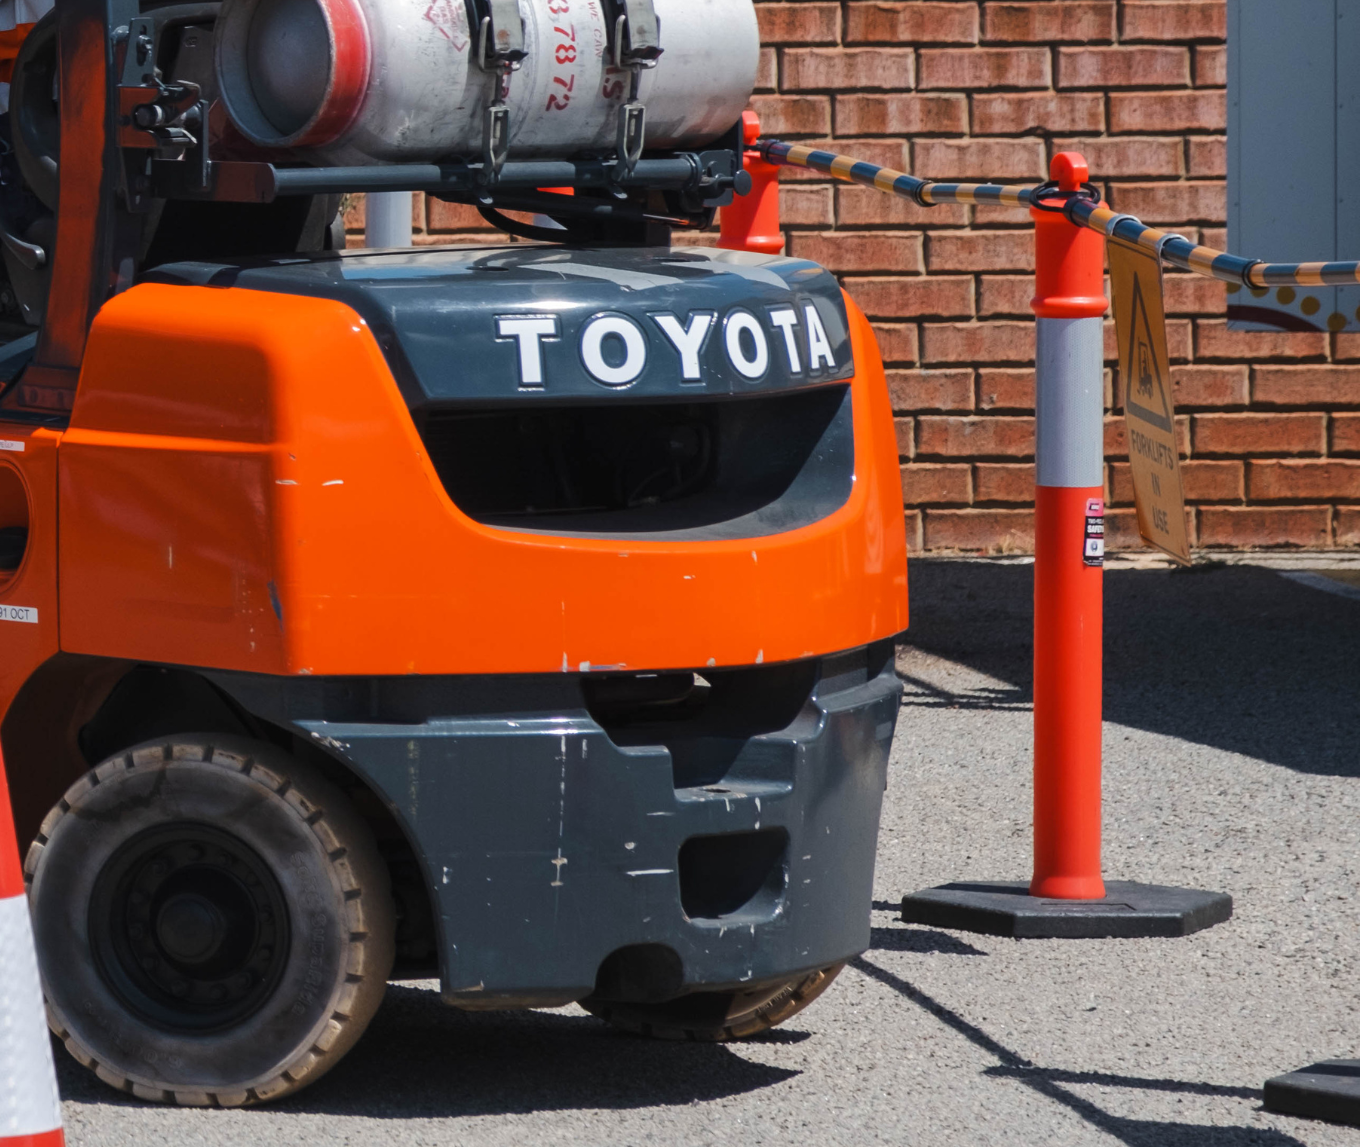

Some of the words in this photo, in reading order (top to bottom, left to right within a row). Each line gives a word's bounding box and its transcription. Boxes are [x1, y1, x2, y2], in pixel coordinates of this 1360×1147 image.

[588, 1, 600, 22] WE
[553, 23, 577, 65] 78
[545, 73, 575, 112] 72
[496, 304, 837, 386] TOYOTA
[1131, 428, 1174, 471] FORKLIFTS
[1151, 472, 1161, 497] IN
[1152, 504, 1170, 535] USE
[10, 608, 30, 620] OCT
